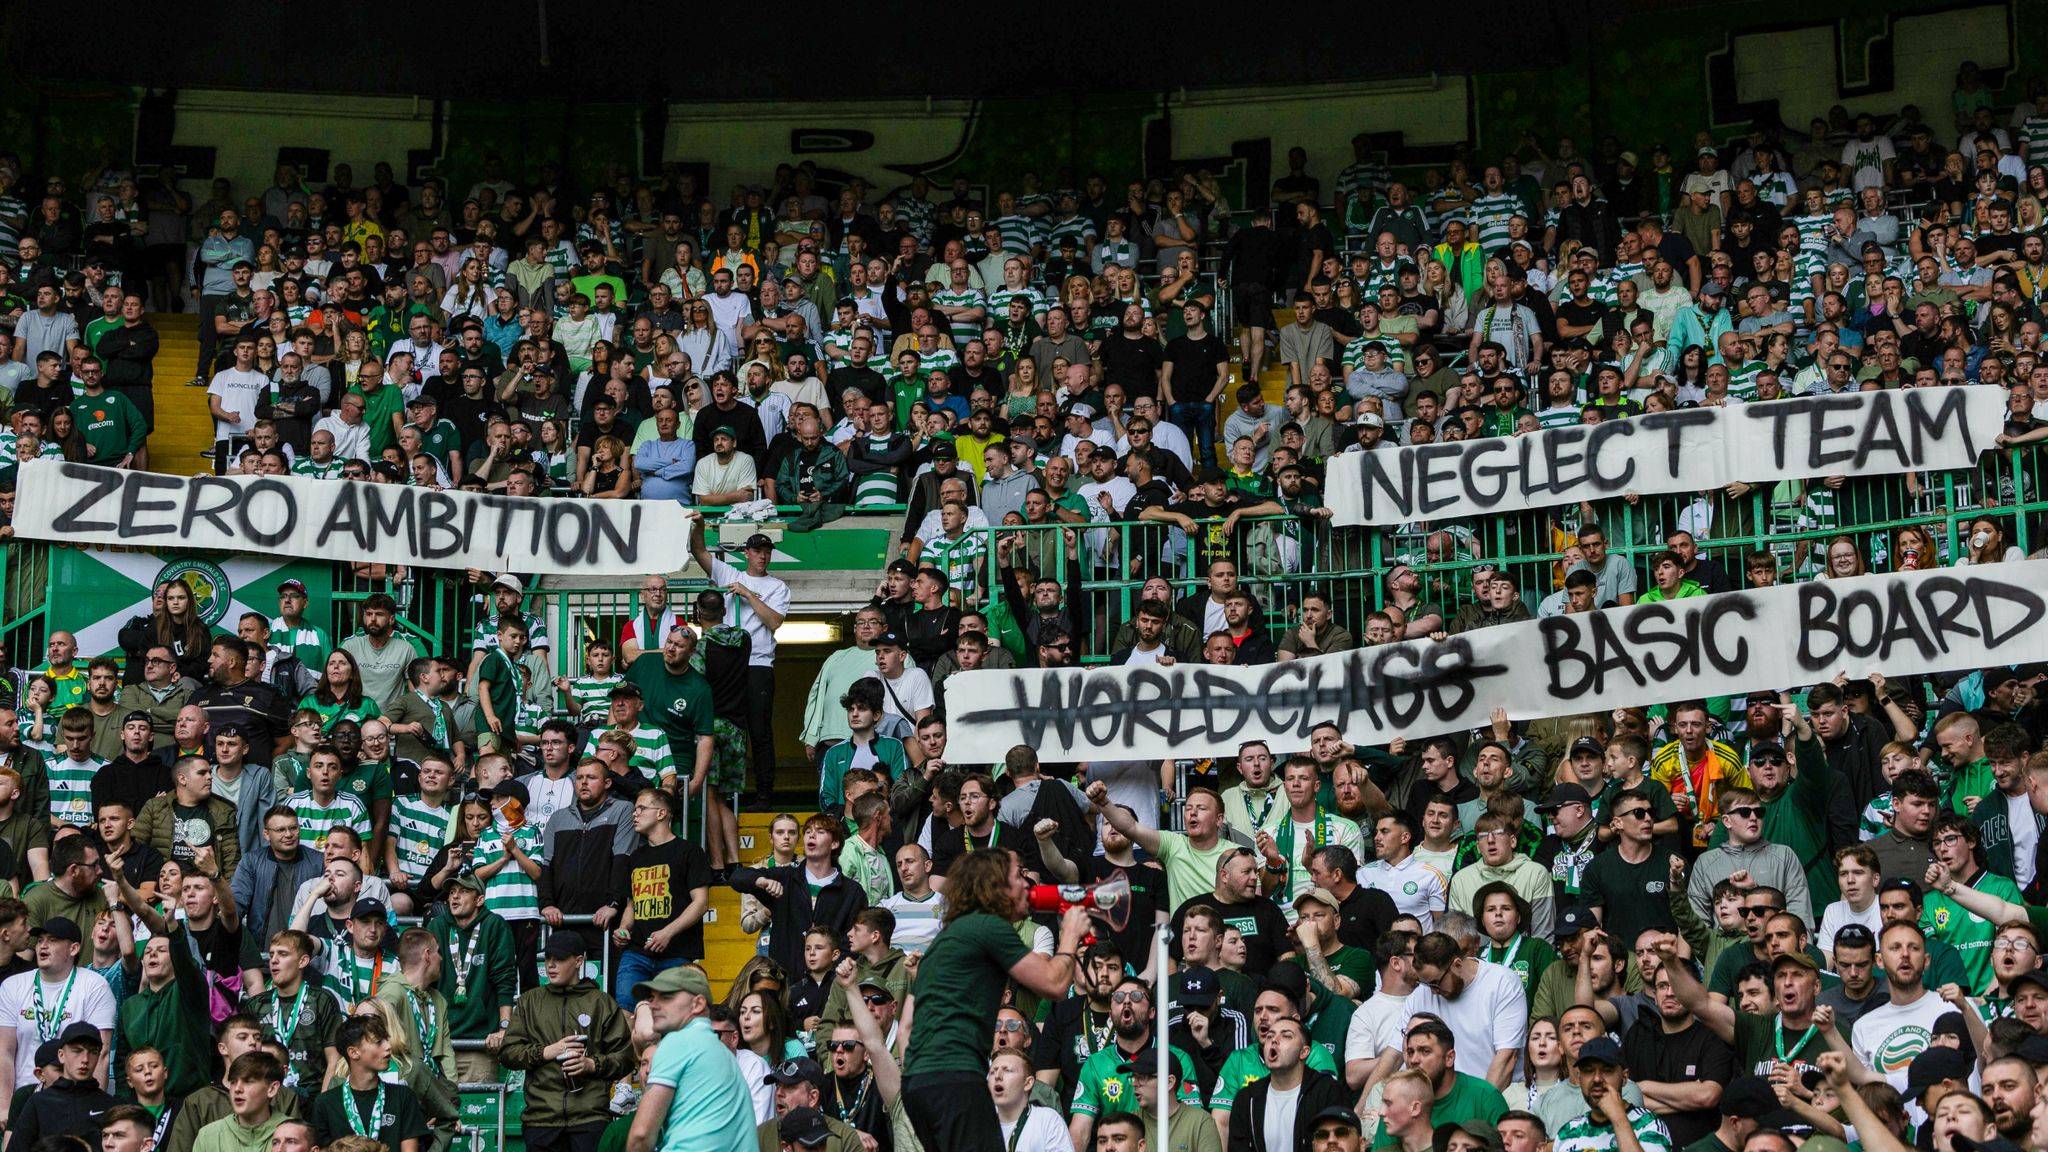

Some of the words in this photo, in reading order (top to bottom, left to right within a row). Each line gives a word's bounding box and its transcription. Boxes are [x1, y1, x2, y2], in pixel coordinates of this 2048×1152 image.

[1362, 411, 1716, 520] NEGLECT
[1748, 388, 1977, 469] TEAM
[51, 462, 298, 548] ZERO
[317, 479, 641, 567] AMBITION
[163, 560, 192, 580] COVENTRY
[192, 561, 219, 578] EMERALD
[1540, 594, 1758, 700] BASIC
[1797, 576, 2047, 673] BOARD
[59, 811, 93, 823] dafab
[406, 851, 433, 865] dafab
[634, 881, 666, 897] HATE
[634, 896, 671, 918] ATCHER
[1876, 1028, 1904, 1058] FOREVER
[1904, 1026, 1922, 1034] AND
